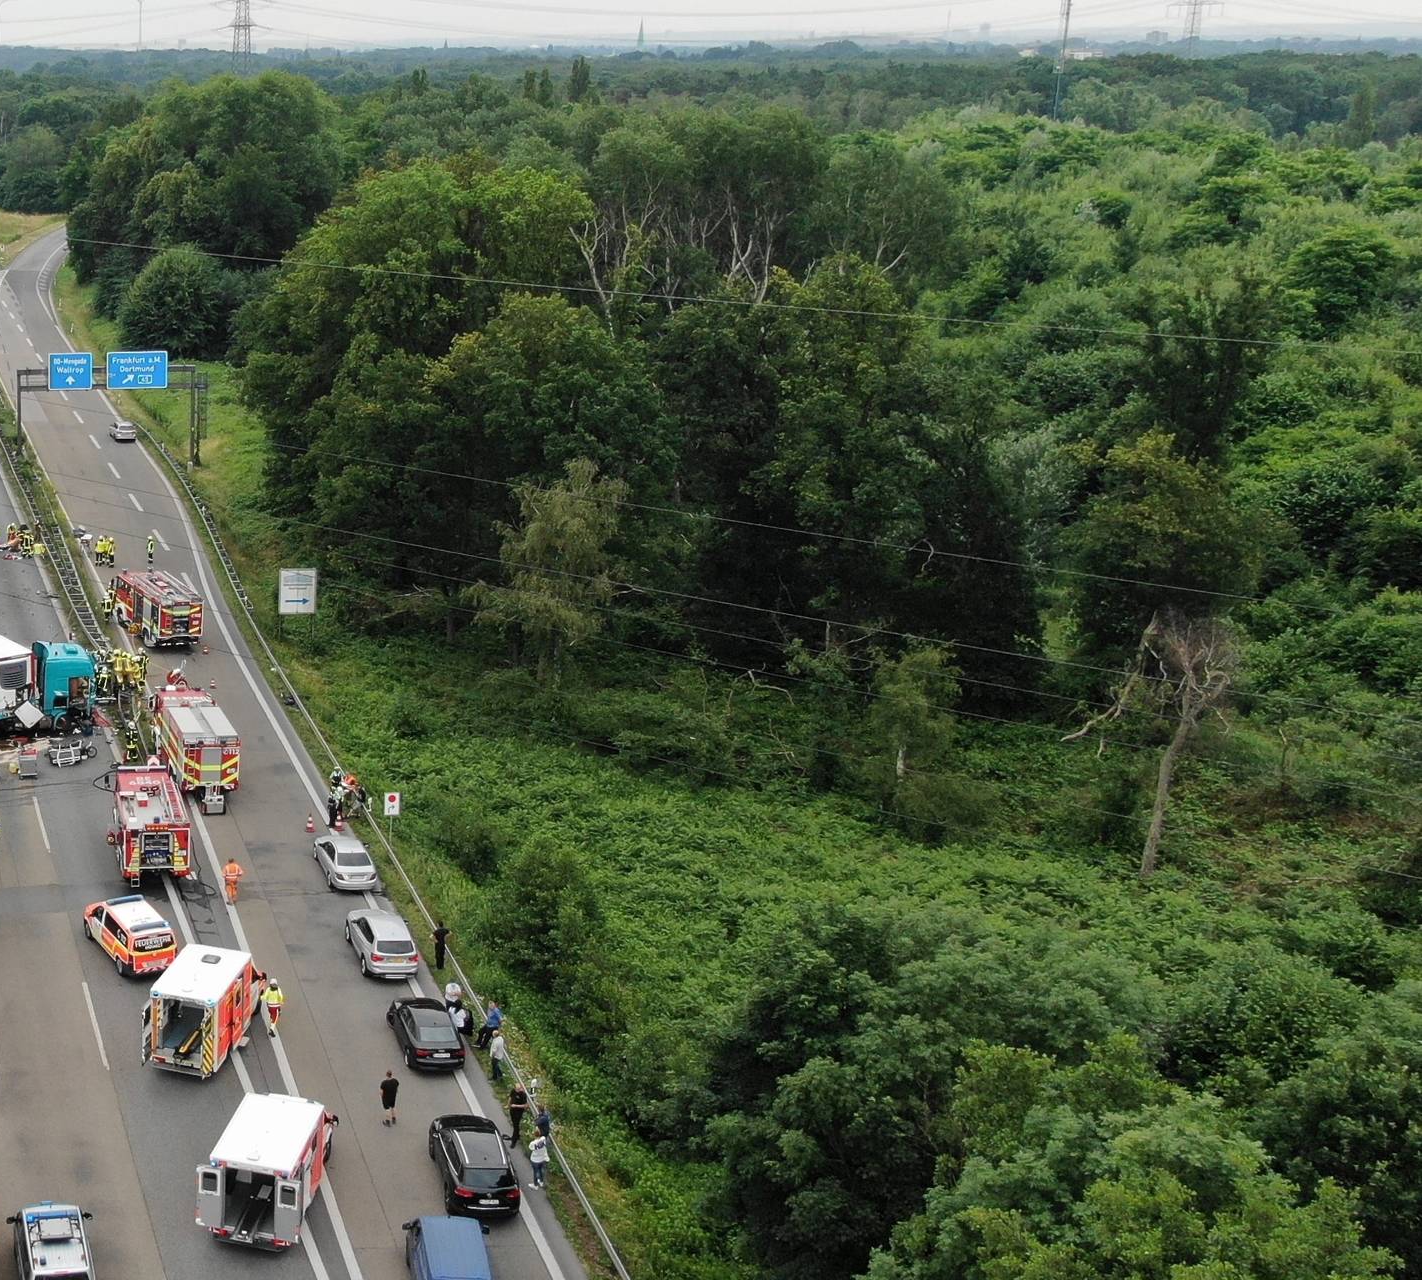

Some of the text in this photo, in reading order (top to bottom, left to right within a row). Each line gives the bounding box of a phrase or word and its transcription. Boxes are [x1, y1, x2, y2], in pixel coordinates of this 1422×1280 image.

[112, 356, 146, 365] Frankfurt
[56, 366, 84, 375] Waltrop
[119, 365, 155, 373] Dortmund
[134, 934, 172, 948] FEUERWEHR
